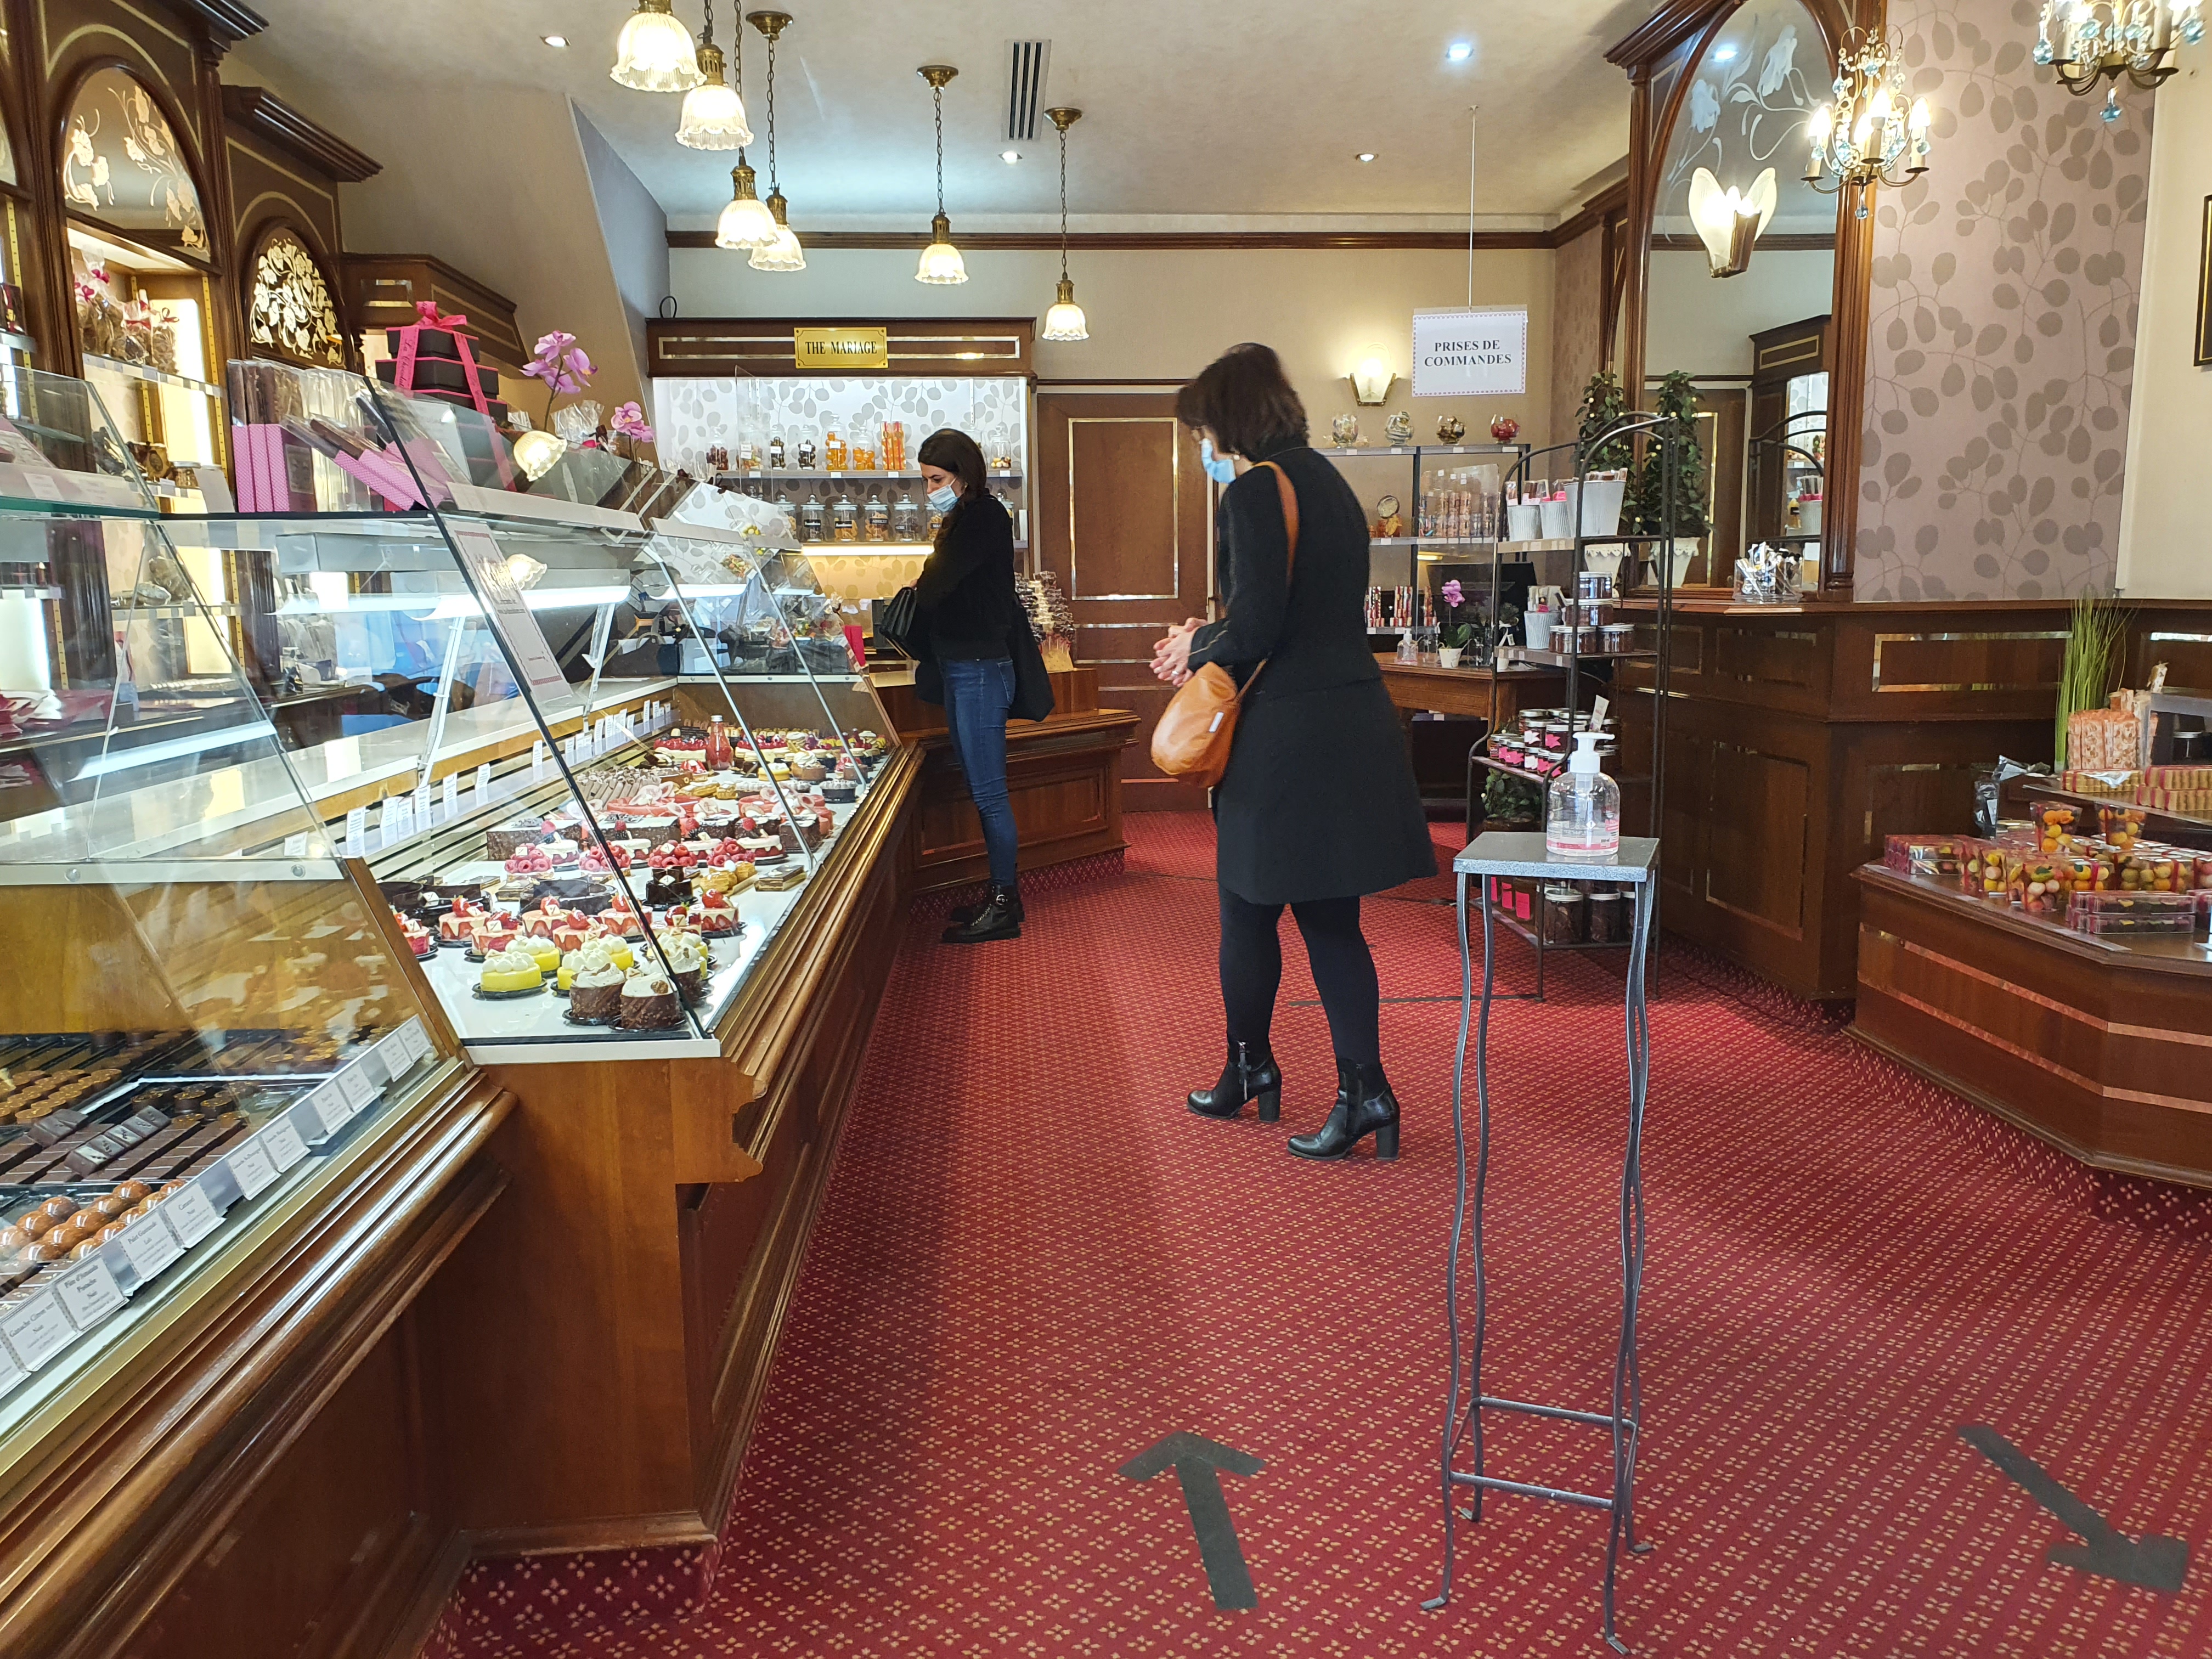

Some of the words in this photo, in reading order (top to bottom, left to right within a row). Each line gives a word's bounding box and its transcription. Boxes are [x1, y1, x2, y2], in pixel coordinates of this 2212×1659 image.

[805, 341, 826, 354] THE
[831, 341, 877, 354] MARIAGE
[1435, 341, 1479, 352] PRISES
[1483, 340, 1500, 350] DE
[1424, 354, 1511, 366] COMMANDES
